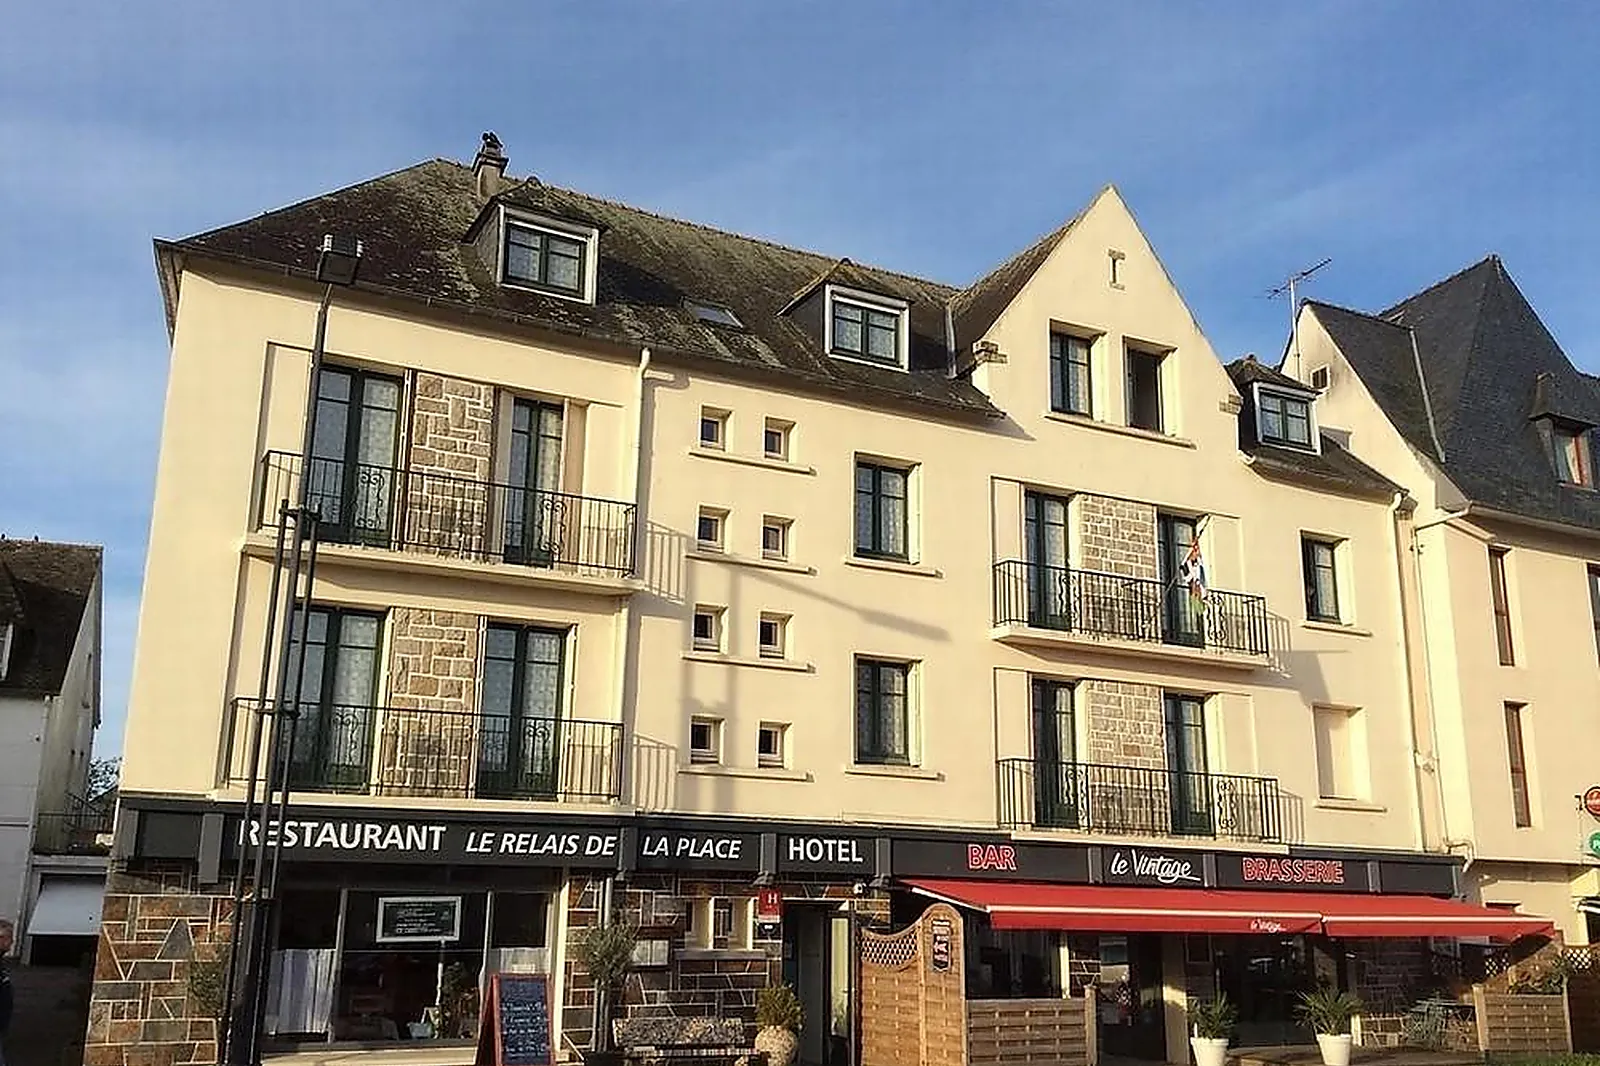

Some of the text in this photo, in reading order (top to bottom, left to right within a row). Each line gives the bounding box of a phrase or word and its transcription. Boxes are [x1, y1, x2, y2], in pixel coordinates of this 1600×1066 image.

[238, 819, 447, 851] RESTAURANT
[465, 831, 618, 856] LE RELAIS DE
[642, 836, 742, 859] LA PLACE
[788, 837, 864, 863] HOTEL
[967, 843, 1017, 871] BAR
[1131, 848, 1201, 884] Vintage
[1242, 857, 1345, 884] BRASSERIE
[767, 892, 778, 904] H
